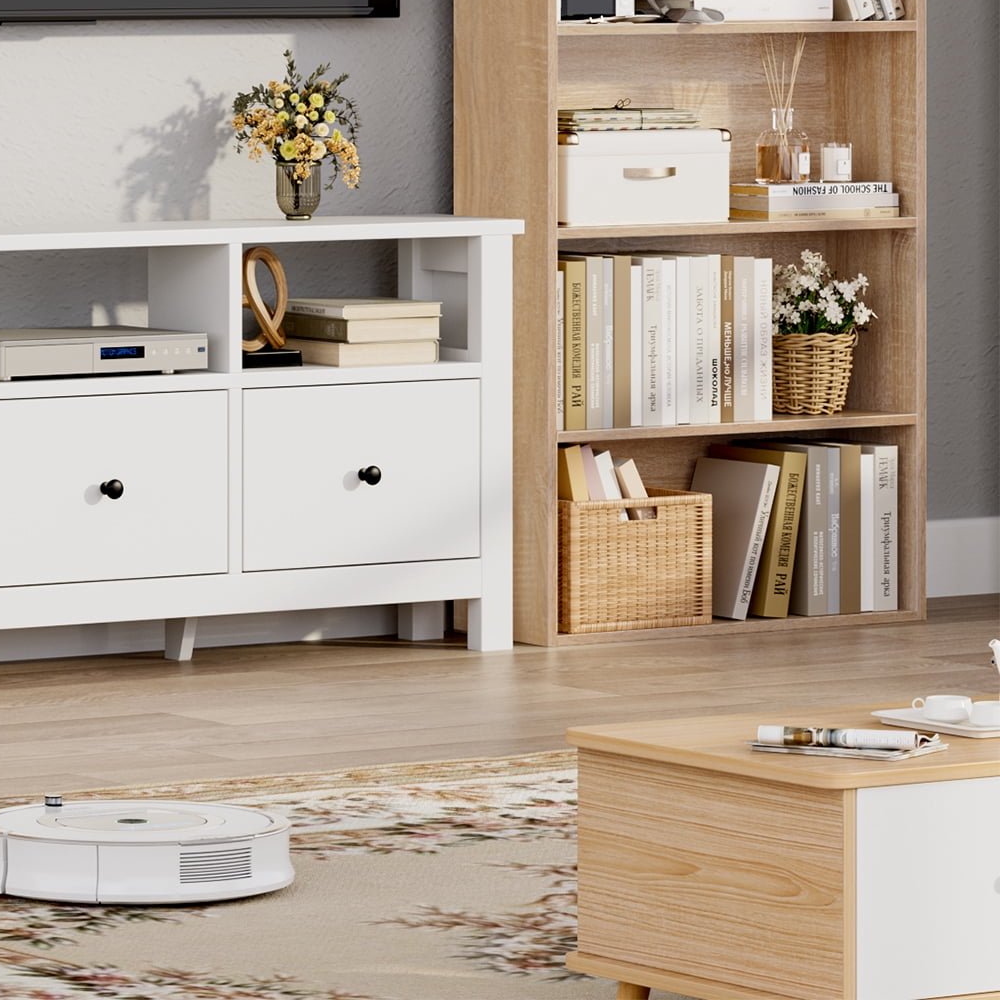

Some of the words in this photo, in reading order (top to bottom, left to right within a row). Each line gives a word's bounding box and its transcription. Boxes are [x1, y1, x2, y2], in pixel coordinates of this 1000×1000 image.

[793, 186, 826, 195] FASHION
[829, 186, 838, 194] OF
[840, 185, 871, 194] SCHOOL
[873, 184, 887, 193] THE
[572, 283, 581, 342] БОЖЕСТВЕННАЯ
[572, 343, 581, 378] КОМЕДИЯ
[571, 385, 584, 407] РАЙ
[649, 392, 657, 412] арка
[782, 473, 799, 531] БОЖЕСТВЕННАЯ
[778, 532, 791, 567] КОМЕДИЯ
[880, 512, 892, 574] Триумфальная
[774, 573, 788, 595] РАЙ
[881, 577, 891, 597] арка
